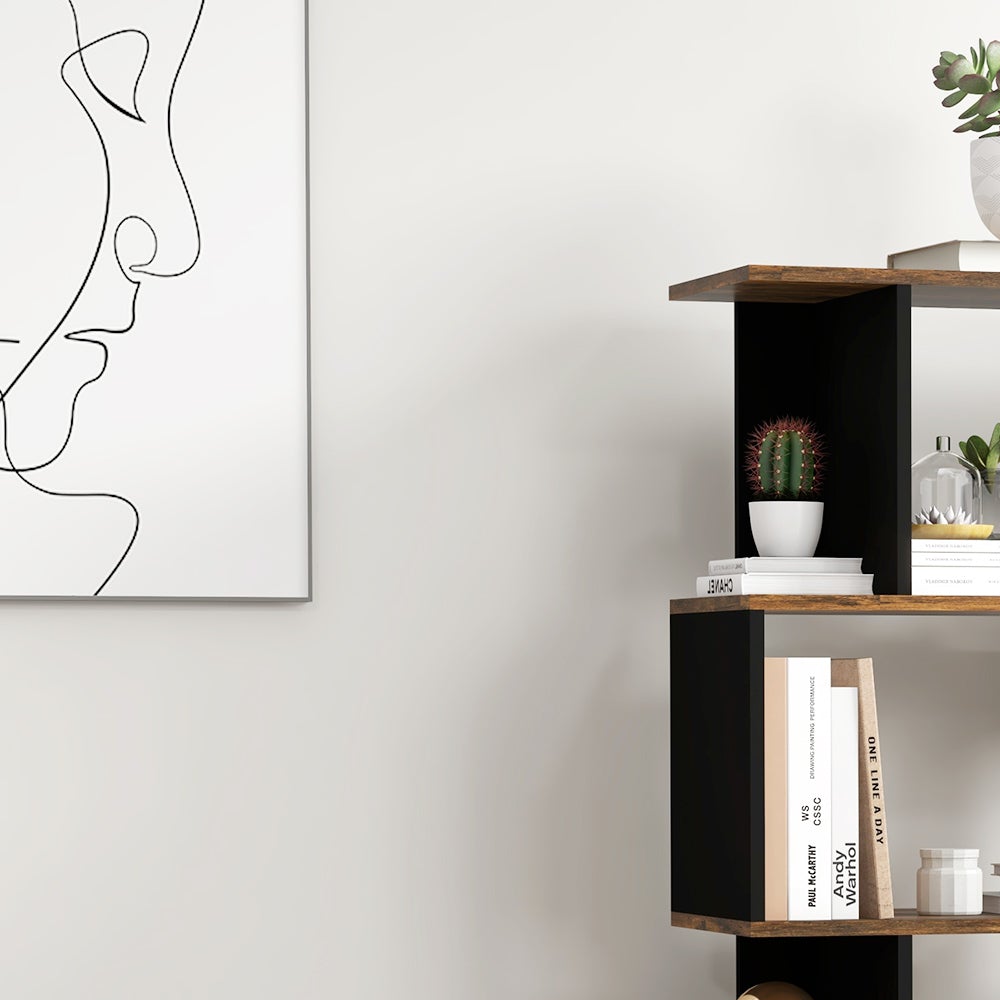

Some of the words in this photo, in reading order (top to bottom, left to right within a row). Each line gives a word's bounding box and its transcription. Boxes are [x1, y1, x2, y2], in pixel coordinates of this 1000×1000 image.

[868, 736, 878, 762] ONE
[871, 770, 880, 799] LINE
[802, 805, 809, 821] WS
[874, 806, 881, 814] A
[875, 819, 884, 844] DAY
[808, 844, 816, 884] McCARTHY
[834, 850, 847, 898] Andy
[846, 843, 856, 906] Warhol
[808, 885, 816, 907] PAUL
